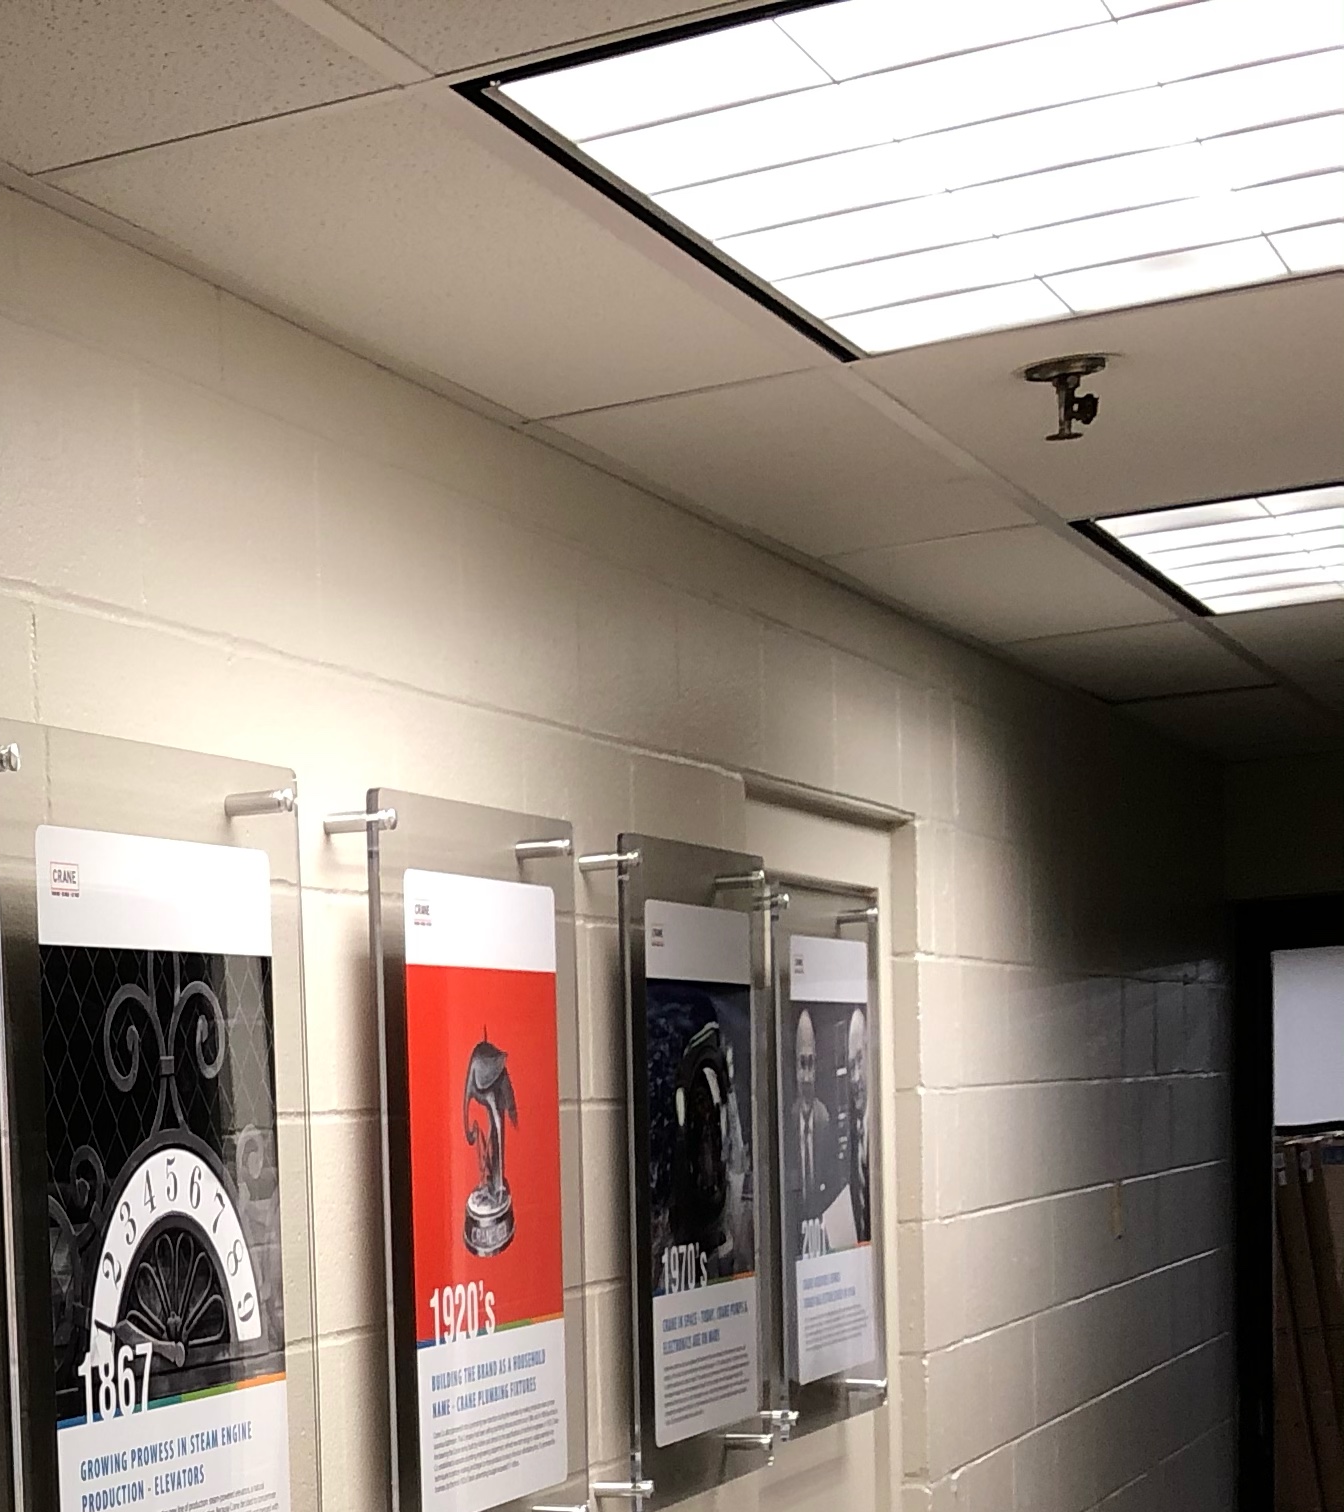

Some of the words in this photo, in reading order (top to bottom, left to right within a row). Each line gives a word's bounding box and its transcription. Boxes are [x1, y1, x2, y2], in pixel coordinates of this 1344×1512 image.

[52, 868, 77, 885] CRANE
[102, 1250, 122, 1290] 2
[120, 1201, 140, 1246] 3
[143, 1168, 158, 1214] 4
[164, 1156, 178, 1202] 5
[189, 1164, 202, 1210] 6
[211, 1191, 227, 1235] 7
[226, 1238, 244, 1277] 8
[238, 1290, 256, 1323] 9
[661, 1241, 708, 1295] 1970's
[429, 1279, 496, 1346] 1920's
[77, 1342, 153, 1425] 1867
[431, 1369, 462, 1392] BUILDING
[463, 1365, 476, 1383] THE
[432, 1398, 450, 1418] NAME
[80, 1450, 127, 1482] GROWING
[130, 1439, 174, 1469] PROWESS
[177, 1436, 187, 1457] IN
[189, 1429, 218, 1454] STEAM
[221, 1420, 252, 1446] ENGINE
[154, 1463, 204, 1496] ELEVATORS
